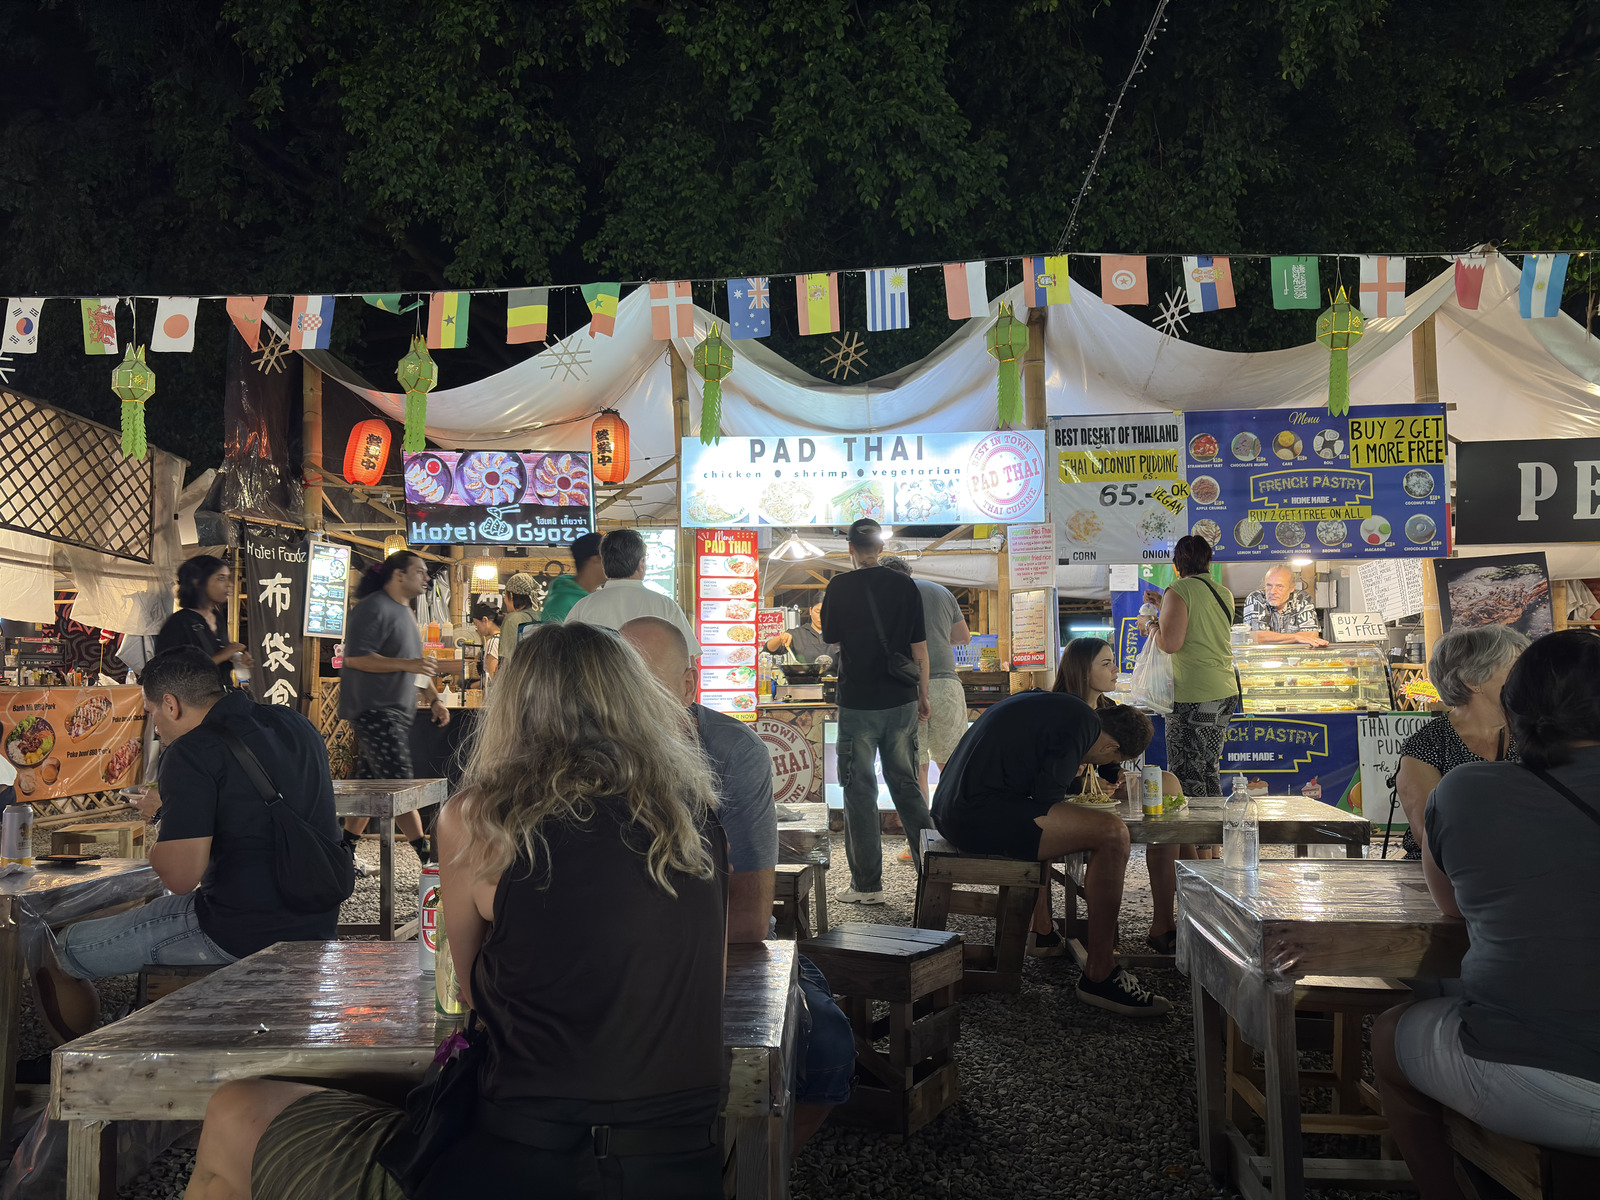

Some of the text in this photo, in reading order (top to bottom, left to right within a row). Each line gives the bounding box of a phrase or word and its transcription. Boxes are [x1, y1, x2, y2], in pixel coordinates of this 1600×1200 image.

[1288, 412, 1320, 425] Menu
[1350, 418, 1442, 440] BUY 2 GET
[1055, 428, 1078, 446] BEST
[1118, 426, 1130, 444] OF
[1131, 424, 1178, 443] THAILAND
[750, 436, 923, 463] PAD THAI
[972, 435, 1032, 466] BEST IN TOWN
[1352, 440, 1444, 464] 1 MORE FREE
[794, 470, 848, 478] shrimp
[872, 467, 960, 478] vegetarian
[972, 458, 1040, 492] PAD THAI
[1061, 454, 1178, 476] THAI COCONUT PUDDING
[1171, 484, 1188, 497] OK
[1258, 475, 1365, 494] FRENCH PASTRY
[1518, 461, 1600, 521] PE
[984, 488, 1037, 515] THAI CUISINE
[1152, 486, 1184, 514] VEGAN
[1250, 508, 1364, 522] BUY 2 GET 1 FREE ON ALL
[412, 522, 590, 542] Hotei Gyoza
[715, 531, 735, 542] Menu
[246, 540, 307, 563] Hotei Foodz
[705, 540, 751, 554] PAD THAI
[1073, 552, 1097, 561] CORN
[1142, 550, 1170, 559] ONION
[1338, 615, 1372, 625] BUY 2
[1356, 624, 1386, 636] FREE
[1126, 623, 1139, 670] PASTRY
[762, 723, 798, 744] TOWN
[1254, 725, 1319, 746] PASTRY
[1360, 717, 1388, 736] THAI
[772, 750, 810, 776] HAI
[1228, 752, 1274, 761] HOME MADE
